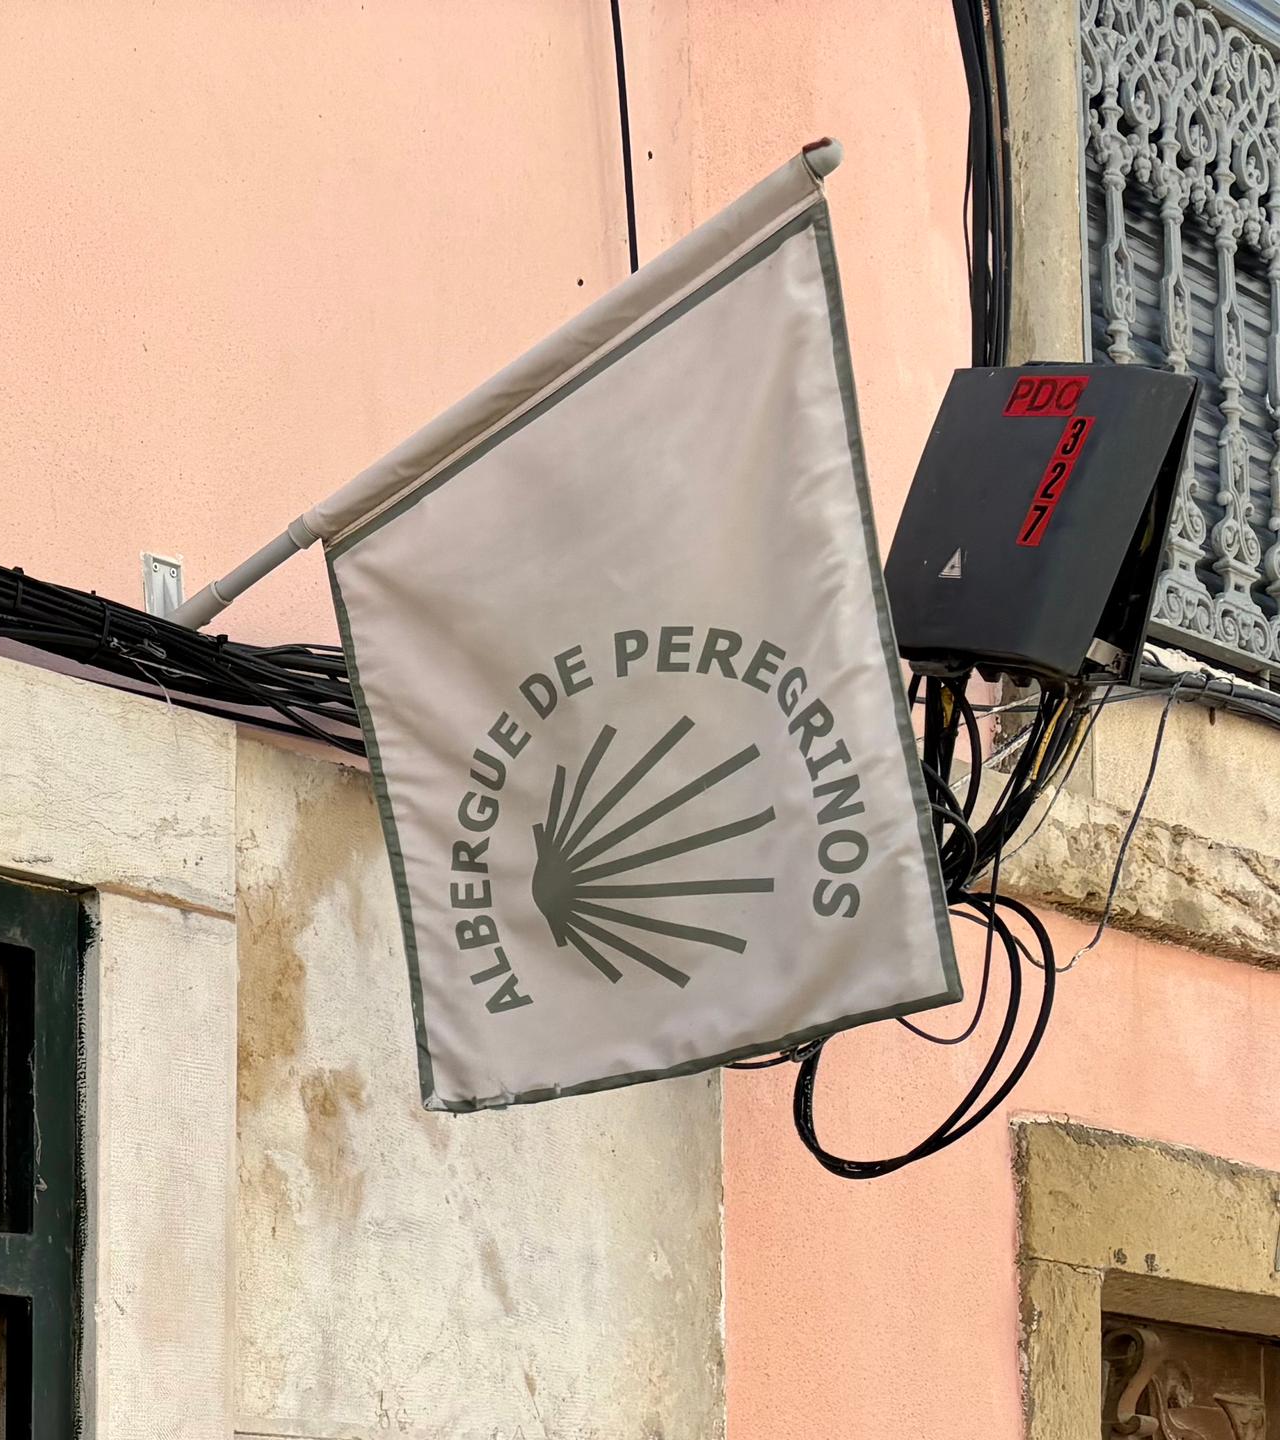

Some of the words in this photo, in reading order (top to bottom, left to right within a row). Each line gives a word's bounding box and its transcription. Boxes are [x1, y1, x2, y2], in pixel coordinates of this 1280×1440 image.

[1005, 379, 1083, 412] PDO
[450, 711, 534, 1014] ALBERGUE
[519, 644, 594, 720] DE
[613, 625, 869, 920] PEREGRINOS
